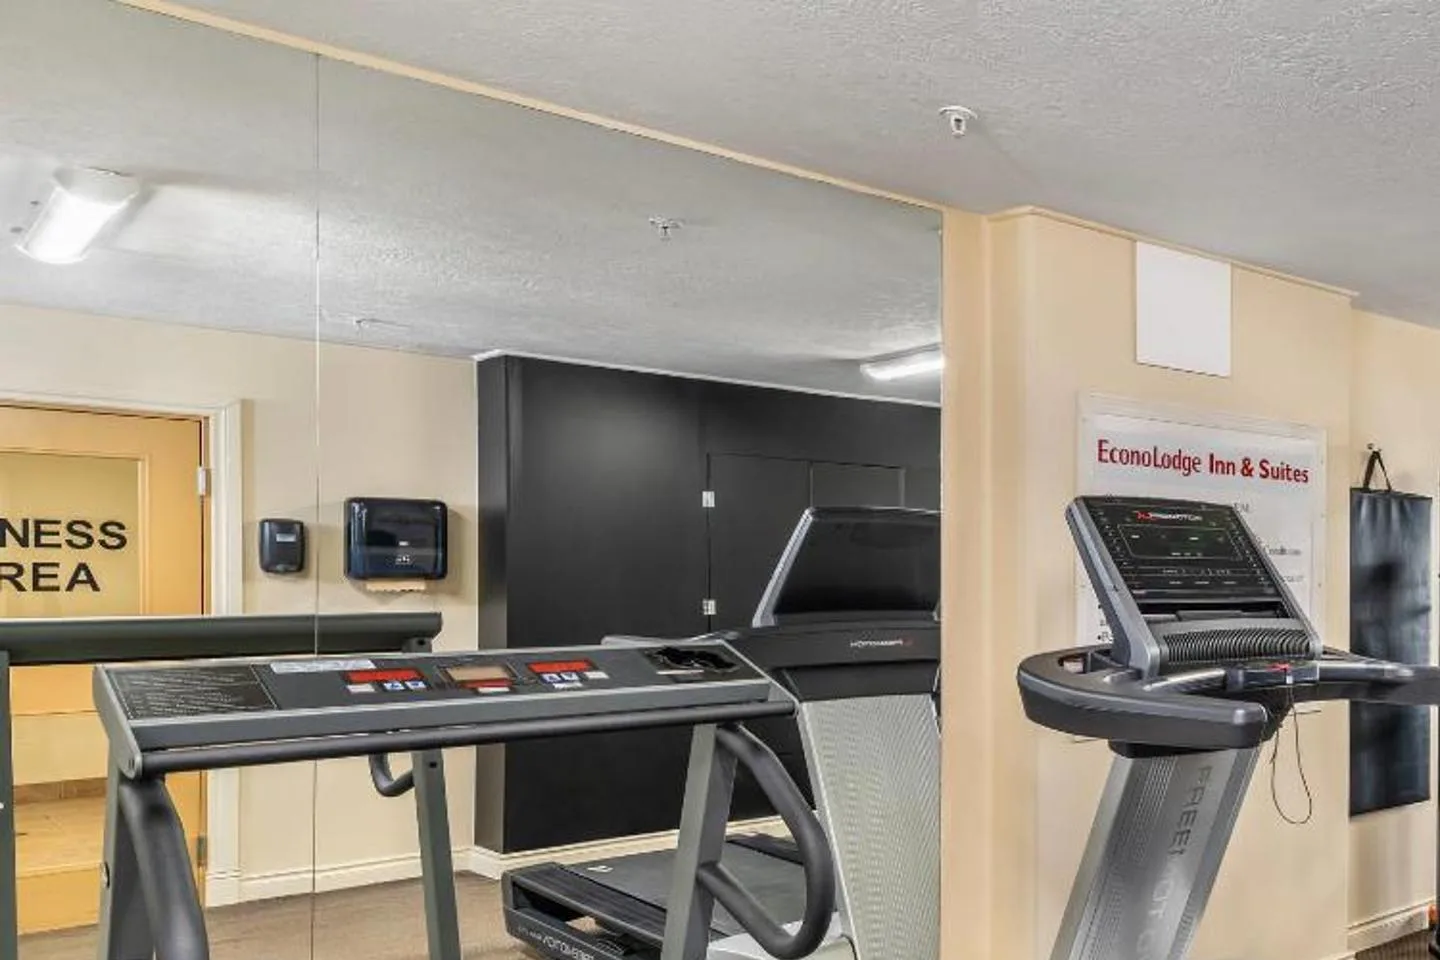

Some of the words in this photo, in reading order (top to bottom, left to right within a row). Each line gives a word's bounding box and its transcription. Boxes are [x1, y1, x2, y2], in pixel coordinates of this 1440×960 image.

[1097, 439, 1202, 477] EconoLodge
[1208, 453, 1236, 476] Inn
[1240, 457, 1254, 477] &
[1258, 459, 1309, 483] Suites
[0, 518, 127, 550] NESS
[0, 562, 101, 592] REA
